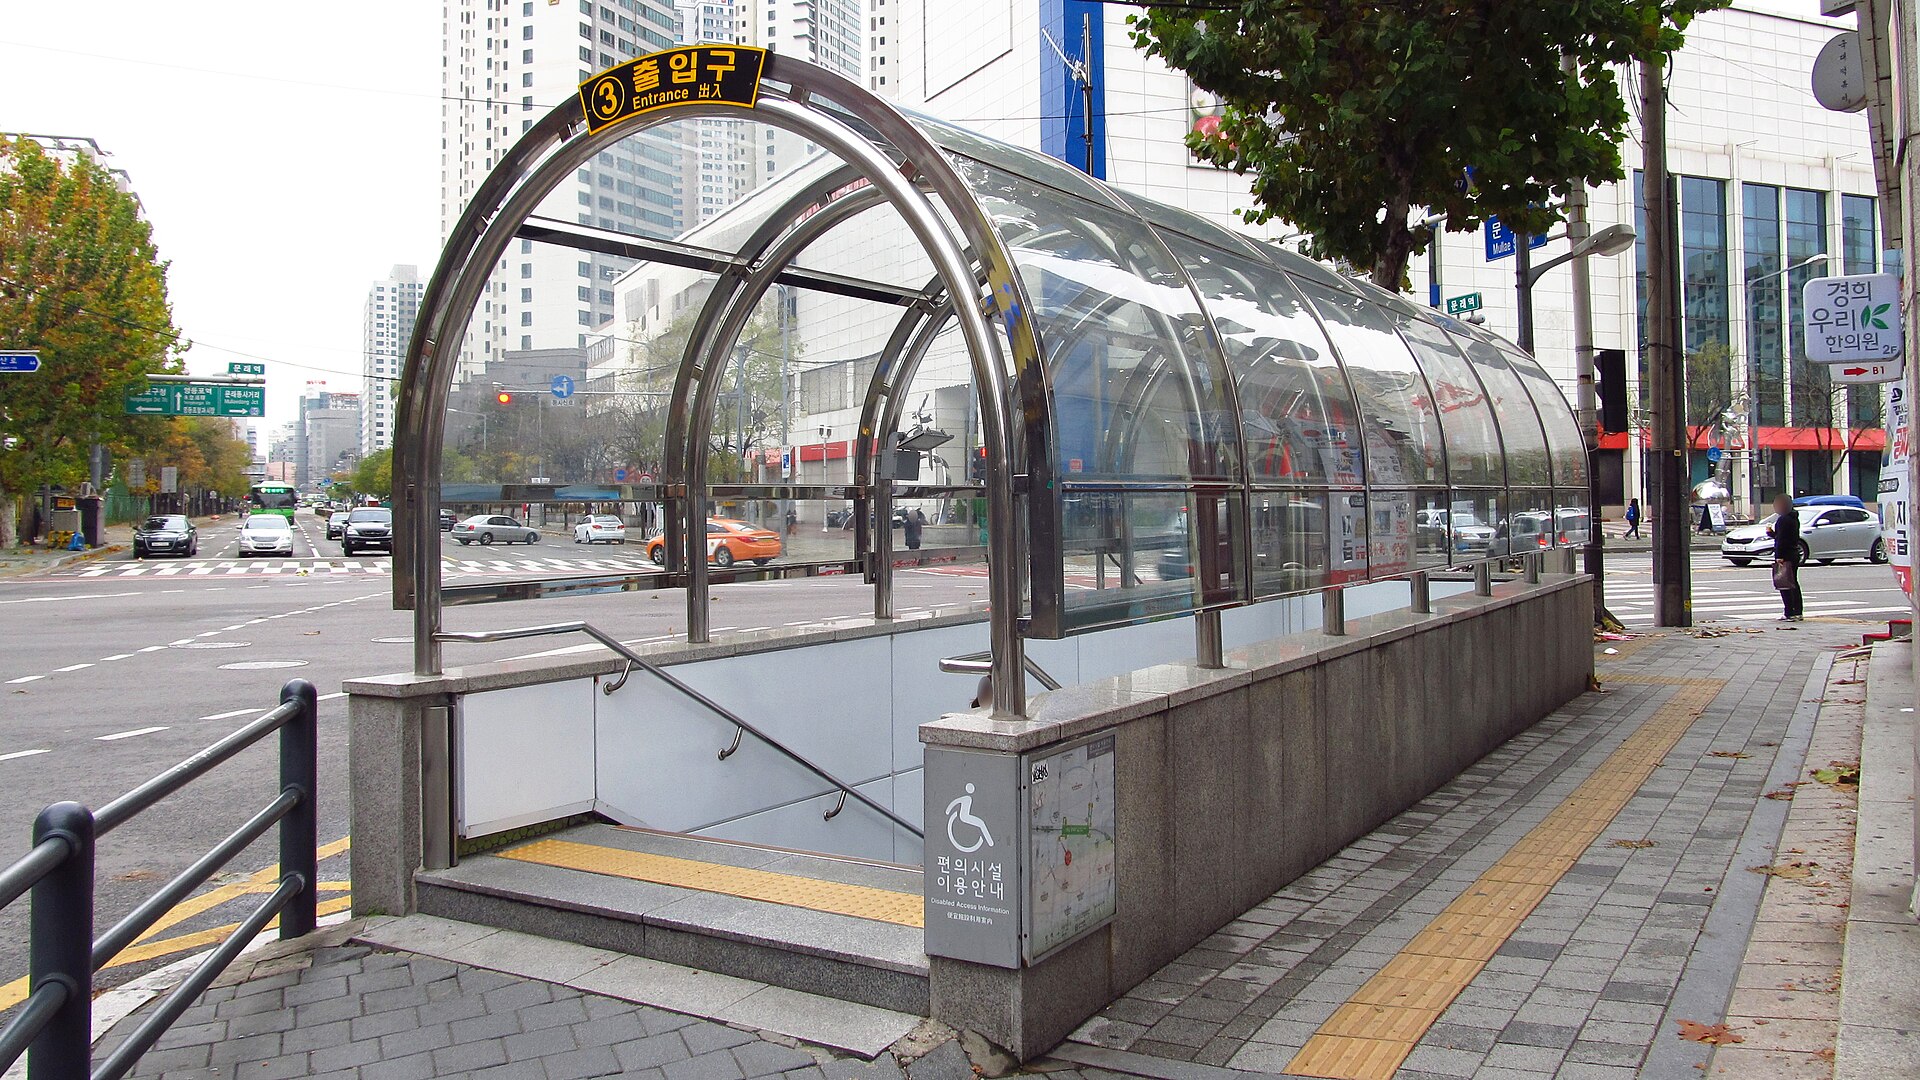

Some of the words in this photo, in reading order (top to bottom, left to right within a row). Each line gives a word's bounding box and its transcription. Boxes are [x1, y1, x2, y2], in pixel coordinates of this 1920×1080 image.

[632, 50, 736, 93] 출입구
[632, 87, 689, 110] Entrance
[698, 83, 722, 99] 出入
[1451, 296, 1475, 311] 문래역
[1808, 308, 1856, 334] 우리
[1825, 333, 1879, 354] 한의원
[1882, 345, 1898, 355] 2F
[233, 364, 261, 374] 문래역
[1872, 366, 1885, 375] B1
[937, 855, 1002, 882] 편의시설
[937, 876, 1004, 901] 이용안내
[930, 897, 955, 907] Disabled
[956, 901, 977, 910] Access
[978, 904, 1010, 915] Information
